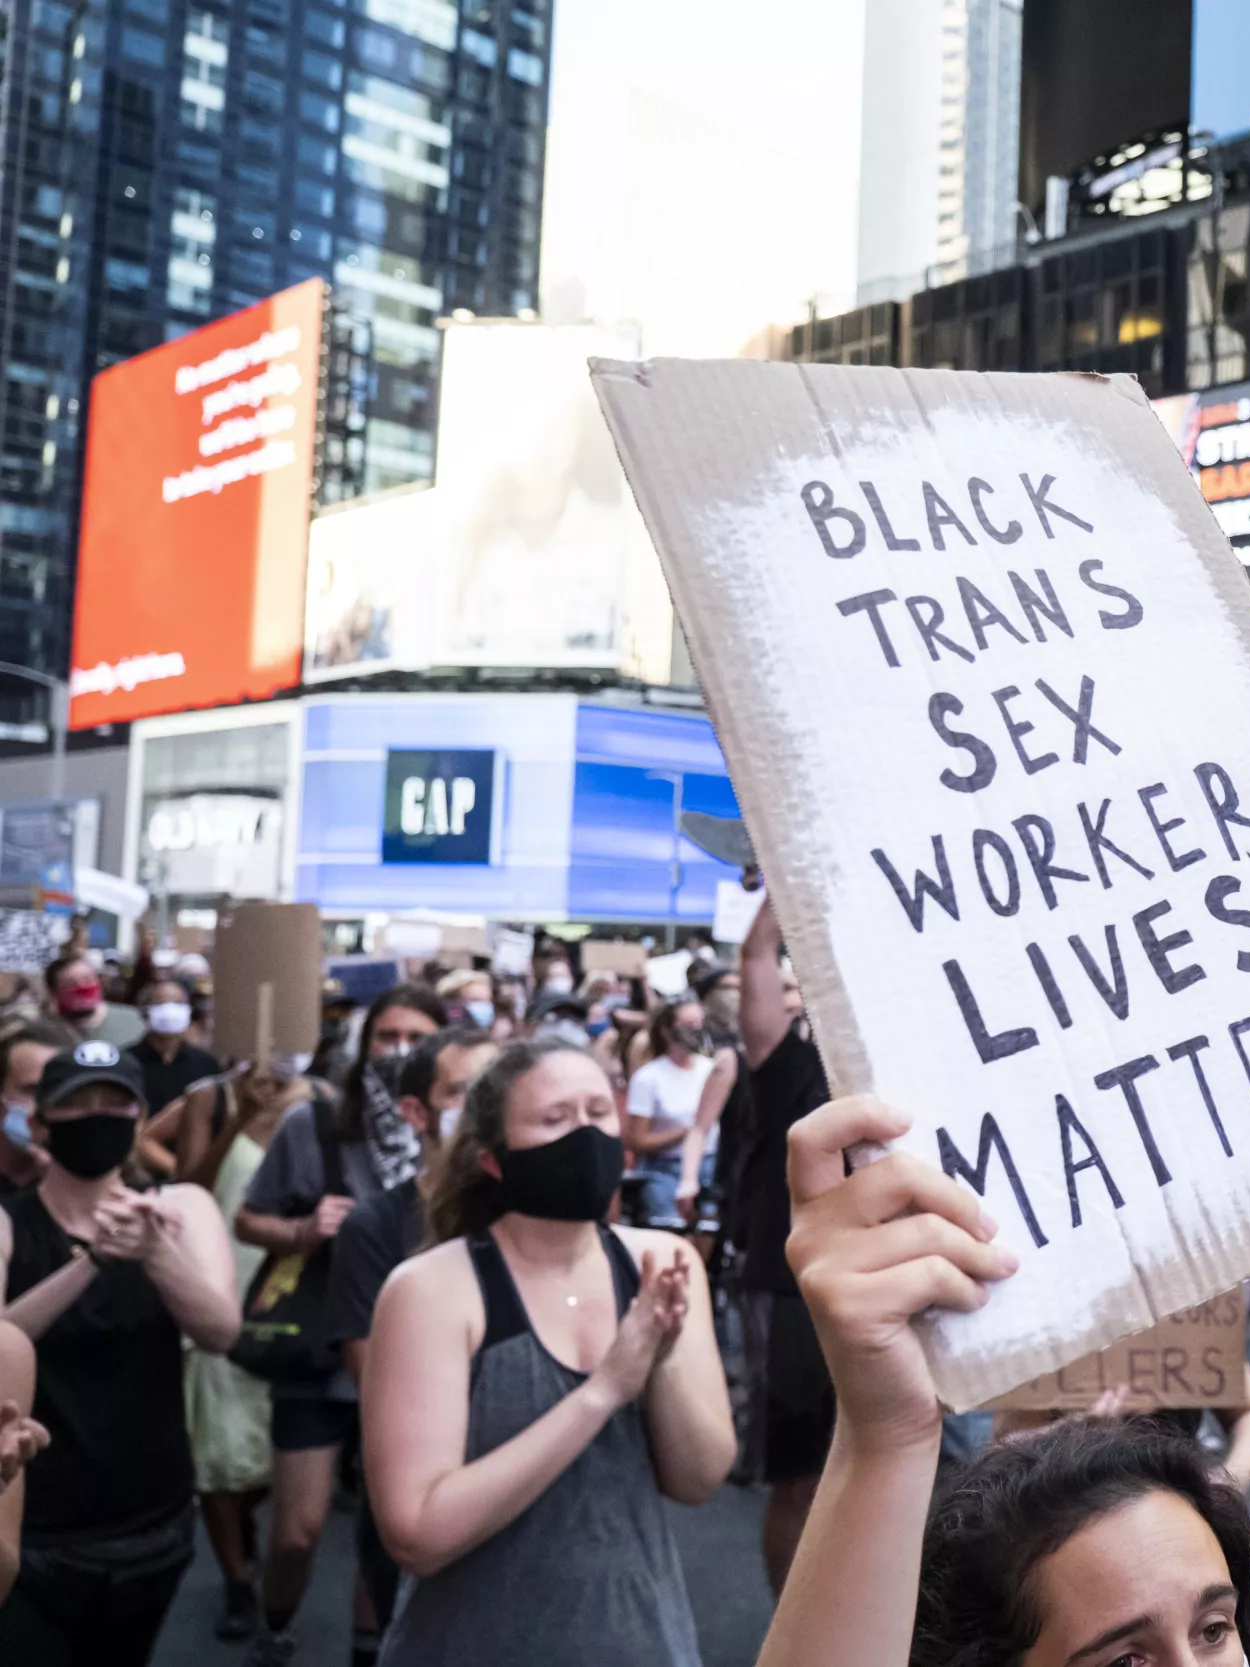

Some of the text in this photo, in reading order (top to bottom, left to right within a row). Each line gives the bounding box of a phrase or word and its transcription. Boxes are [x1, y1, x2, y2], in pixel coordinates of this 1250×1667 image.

[800, 472, 1094, 560] BLACK
[836, 558, 1144, 669] TRANS
[927, 674, 1122, 794] SEX
[401, 776, 477, 836] GAP
